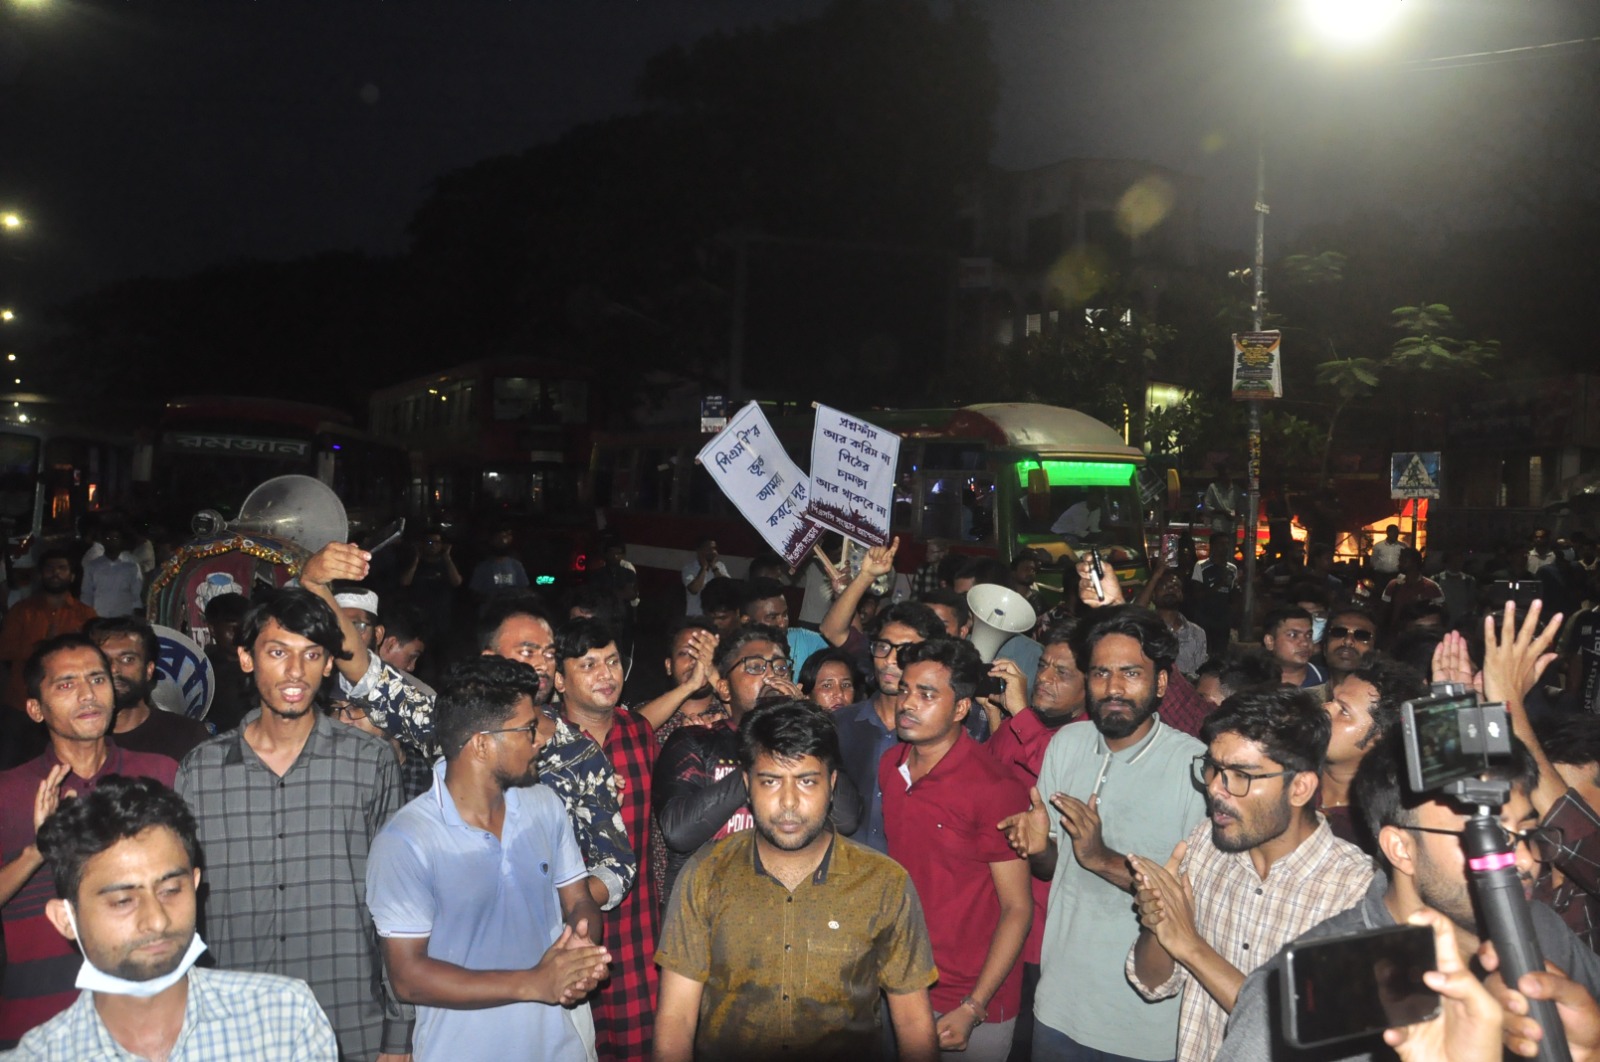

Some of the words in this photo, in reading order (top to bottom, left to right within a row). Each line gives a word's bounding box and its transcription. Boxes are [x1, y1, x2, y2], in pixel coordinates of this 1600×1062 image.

[839, 417, 877, 440] প্রশ্নফাঁস
[176, 434, 309, 456] রমজান
[823, 428, 847, 443] আর
[850, 438, 878, 458] করিস
[880, 452, 891, 466] না
[838, 448, 871, 472] পিঠের
[756, 471, 784, 501] আমরা
[837, 468, 868, 490] চামড়া
[766, 495, 796, 528] করবো
[790, 481, 807, 501] দূর
[815, 476, 840, 494] আর
[842, 488, 874, 511] থাকবে
[876, 504, 887, 518] না
